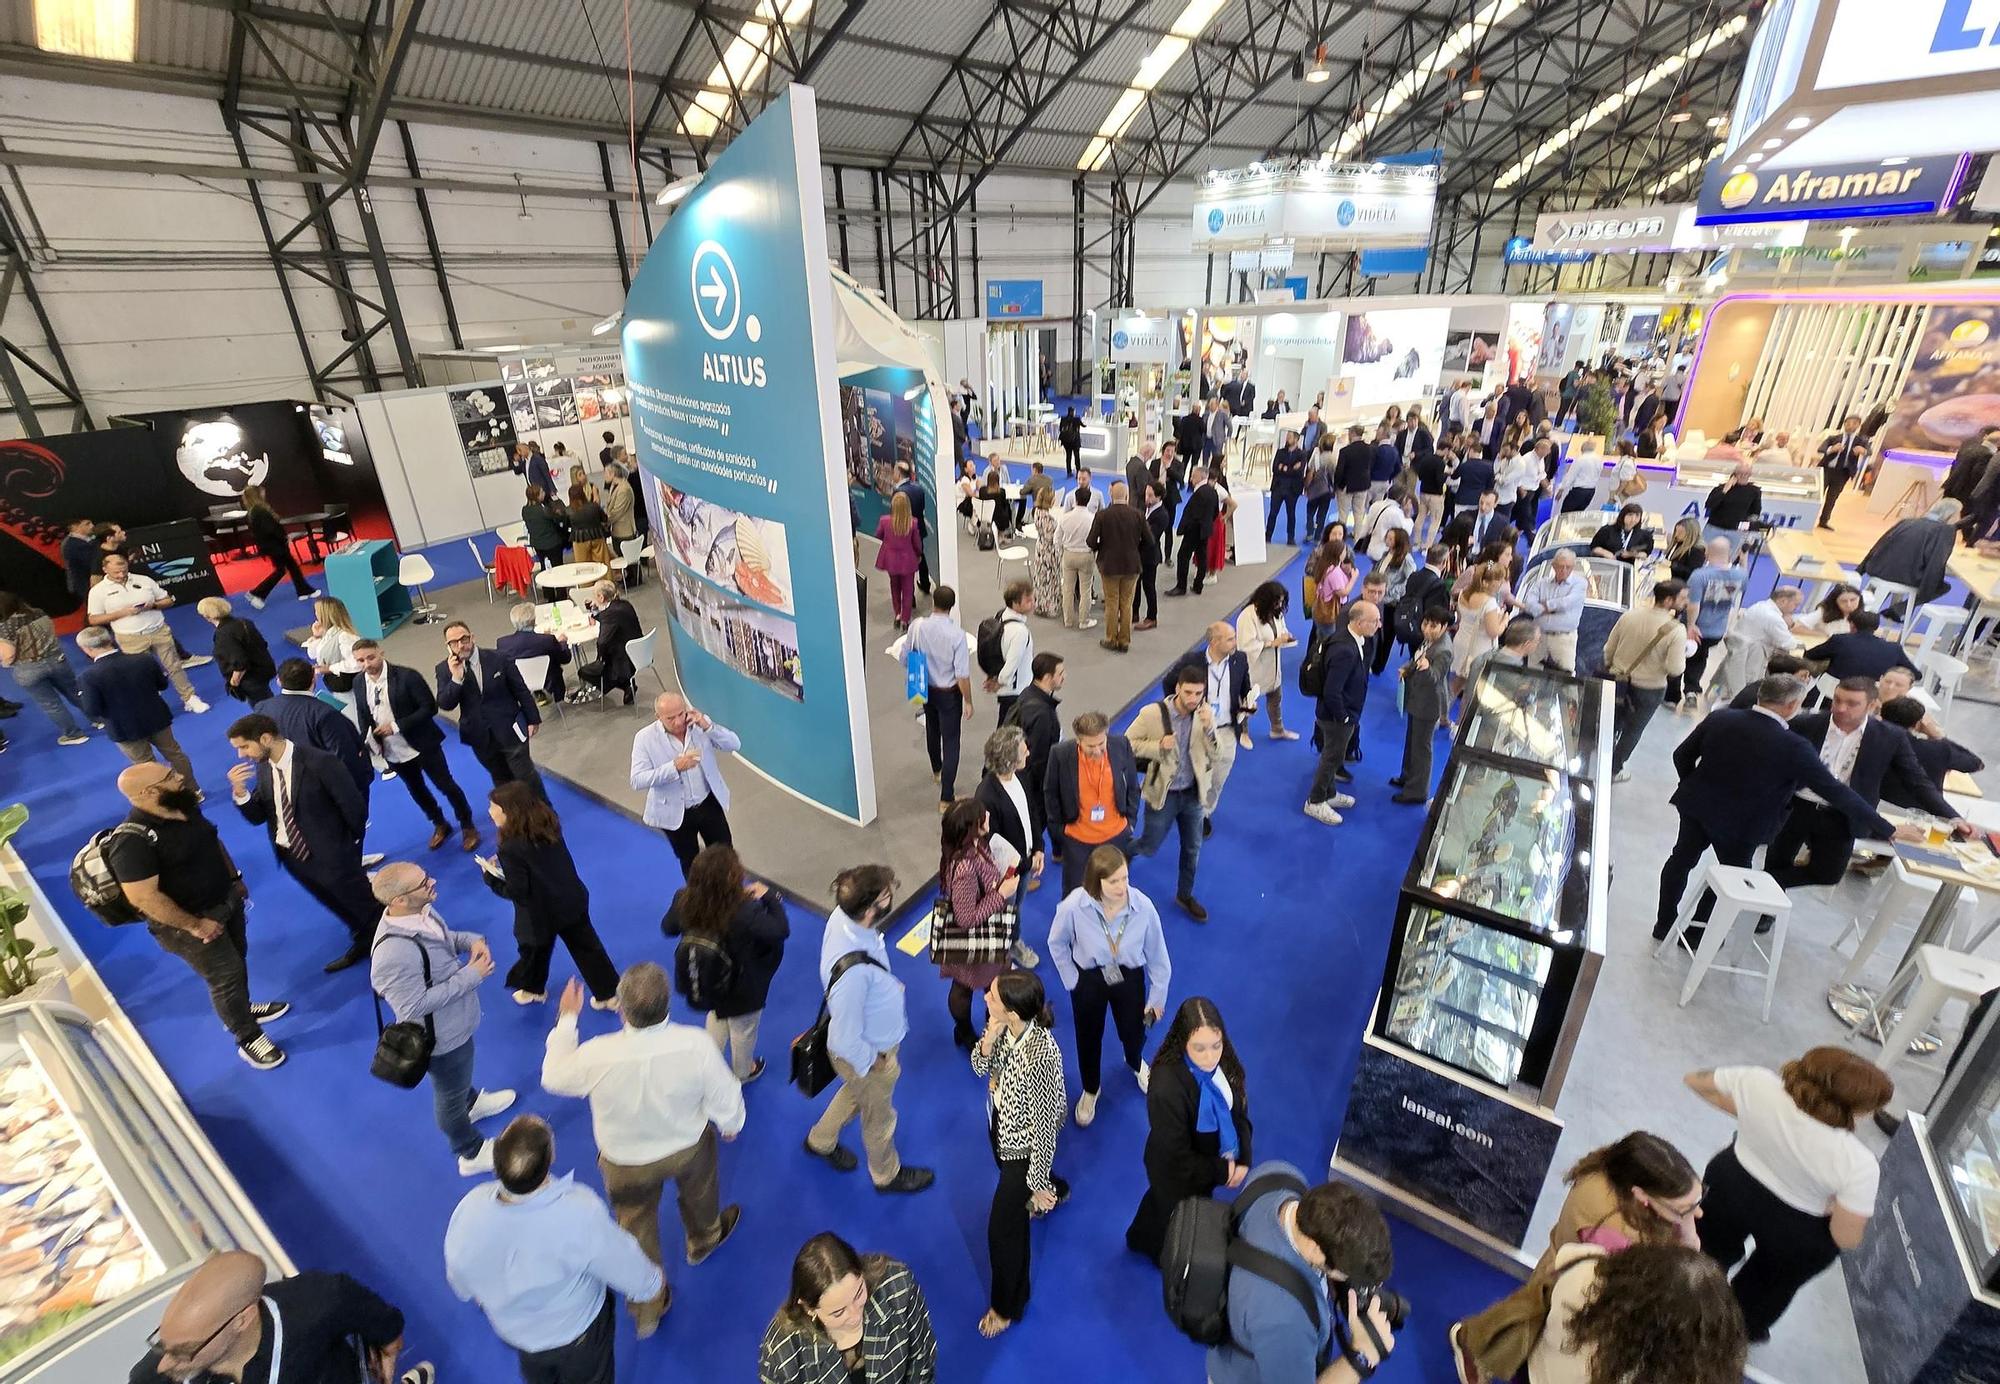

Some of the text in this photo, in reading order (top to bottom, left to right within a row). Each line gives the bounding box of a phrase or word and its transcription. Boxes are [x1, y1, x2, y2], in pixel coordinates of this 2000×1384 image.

[1762, 167, 1923, 204] Aframar
[1226, 209, 1266, 226] VIDELA
[1357, 207, 1397, 223] VIDELA
[1130, 336, 1168, 346] VIDELA
[703, 352, 767, 388] ALTIUS
[699, 400, 731, 416] avanzadas
[716, 449, 724, 461] de
[725, 452, 751, 468] sanidad
[751, 458, 757, 469] e
[733, 469, 766, 487] portuarias
[1402, 1094, 1493, 1149] lanzal.com
